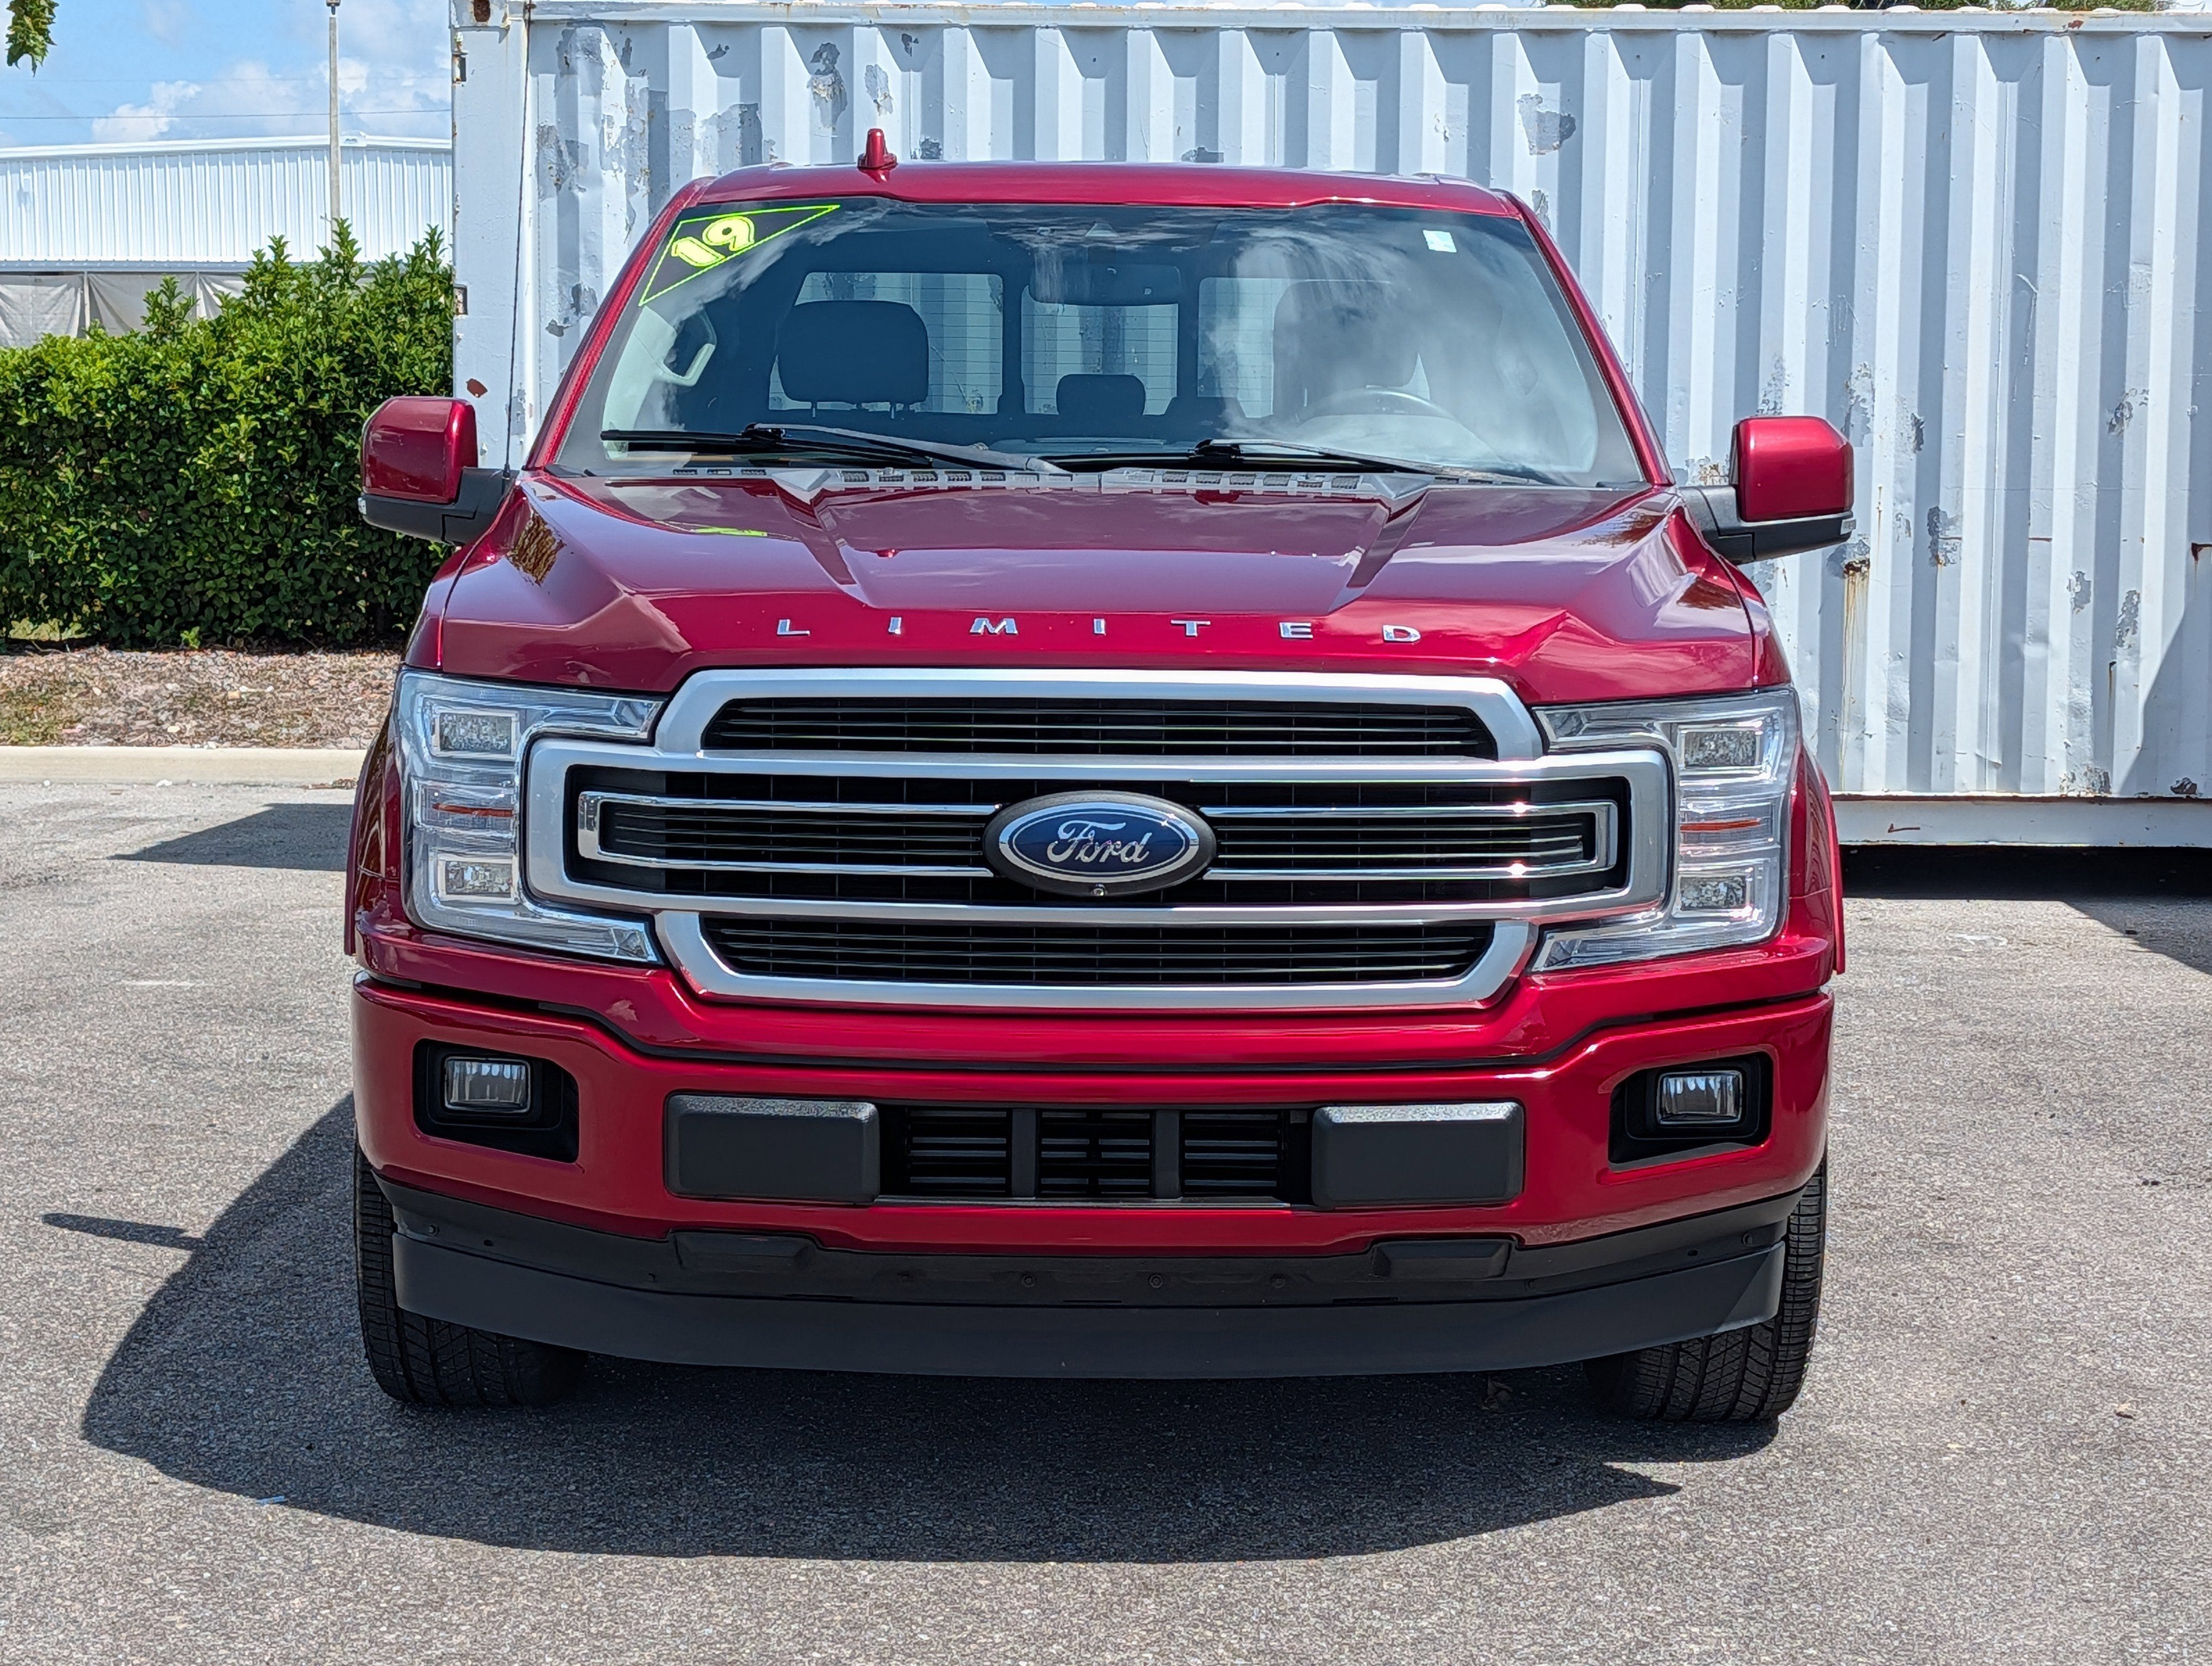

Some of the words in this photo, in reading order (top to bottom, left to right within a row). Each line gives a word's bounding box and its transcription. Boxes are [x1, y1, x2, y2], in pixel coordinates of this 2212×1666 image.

[671, 215, 755, 267] 19
[776, 617, 1422, 643] LIMITED
[1046, 819, 1153, 863] Ford
